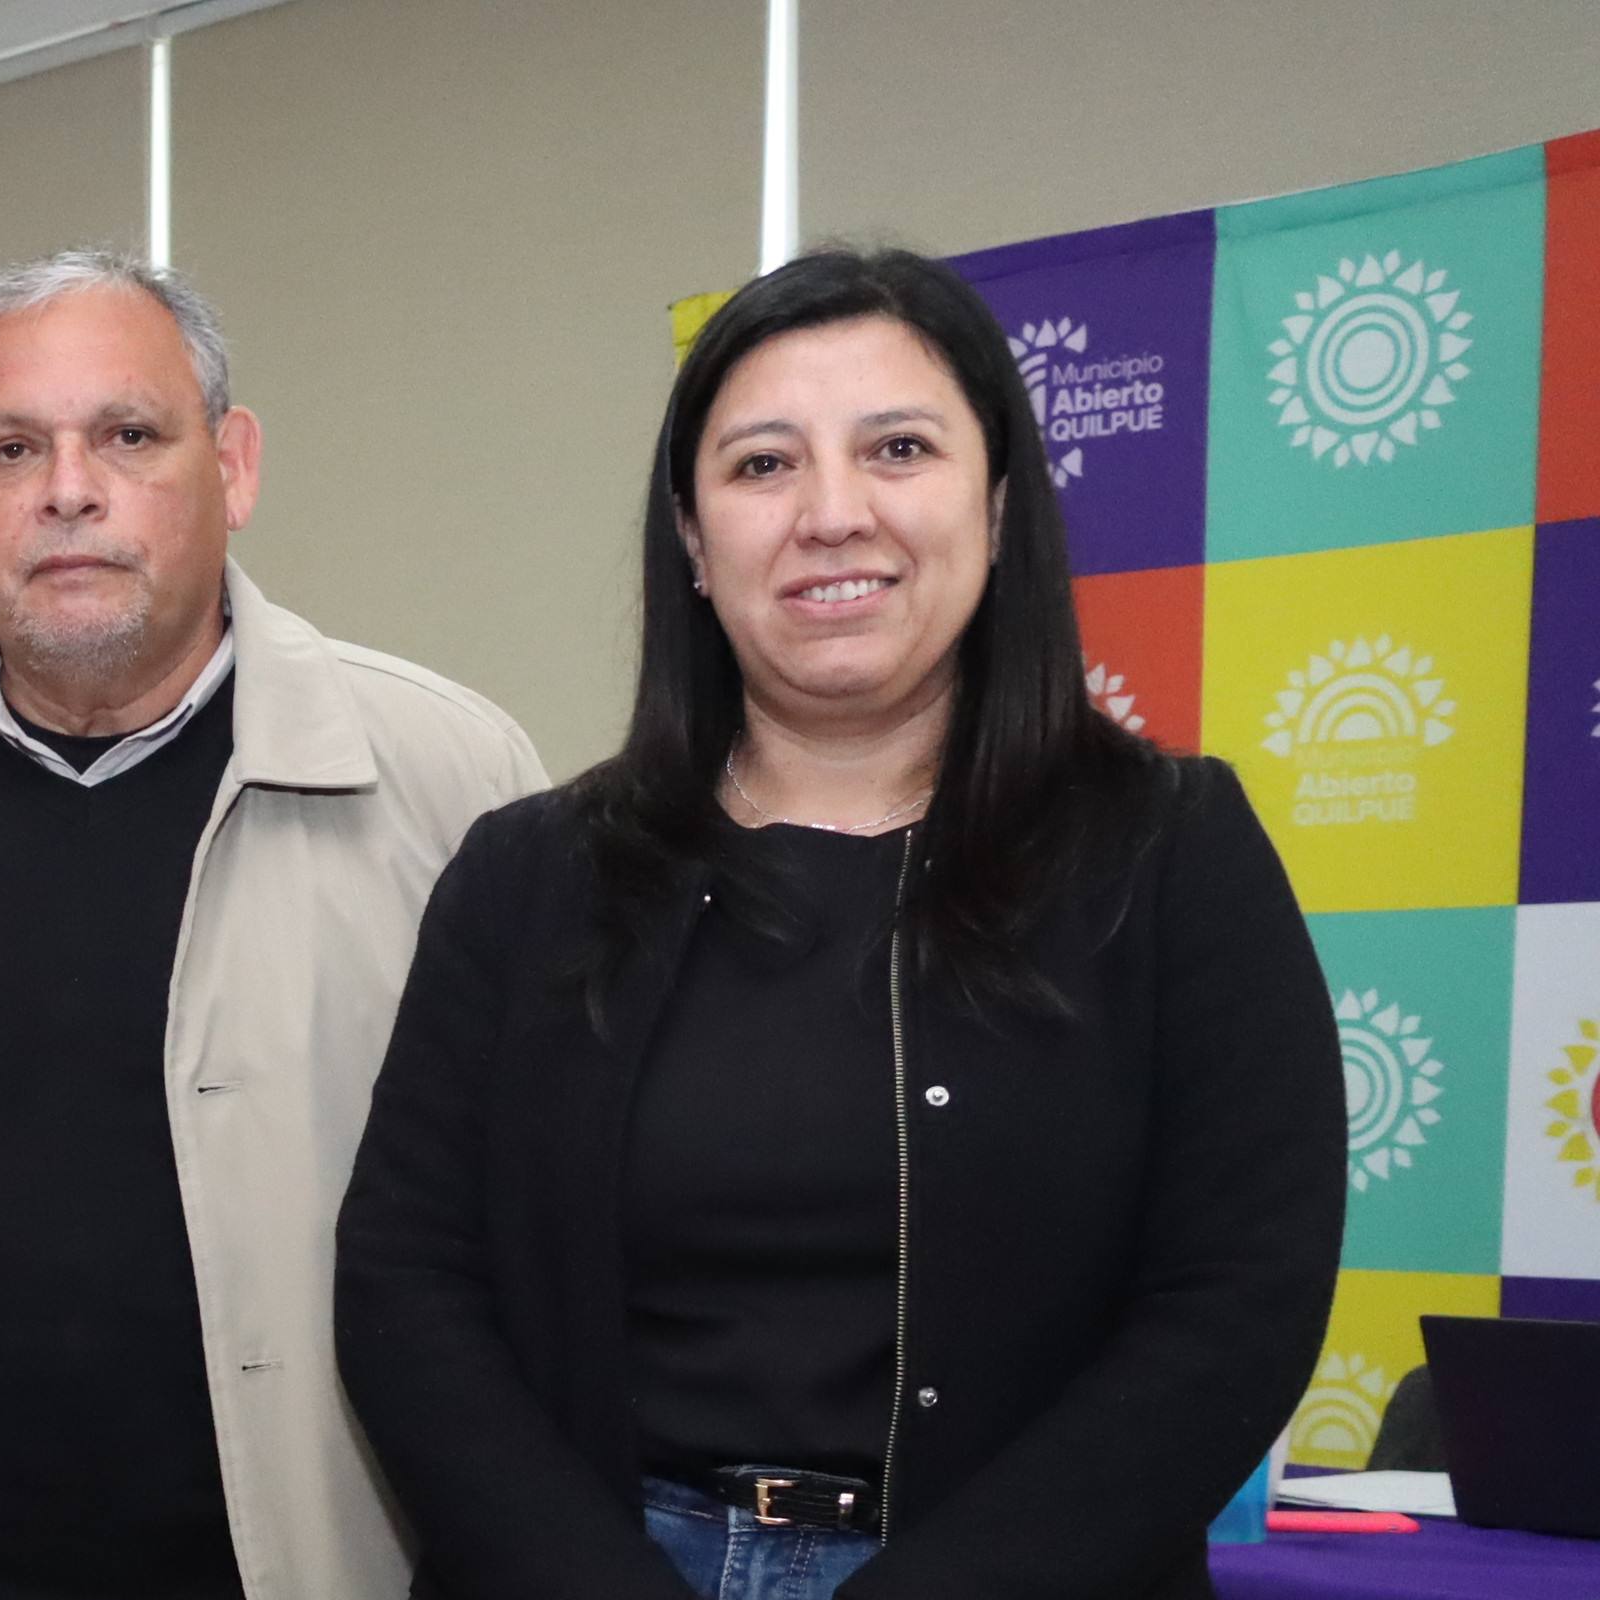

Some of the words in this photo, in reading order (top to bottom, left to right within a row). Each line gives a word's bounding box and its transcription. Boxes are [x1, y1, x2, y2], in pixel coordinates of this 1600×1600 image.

[1051, 352, 1164, 386] Municipio
[1052, 379, 1164, 416] Abierto
[1050, 403, 1164, 441] QUILPUÉ
[1296, 771, 1417, 798] Abierto
